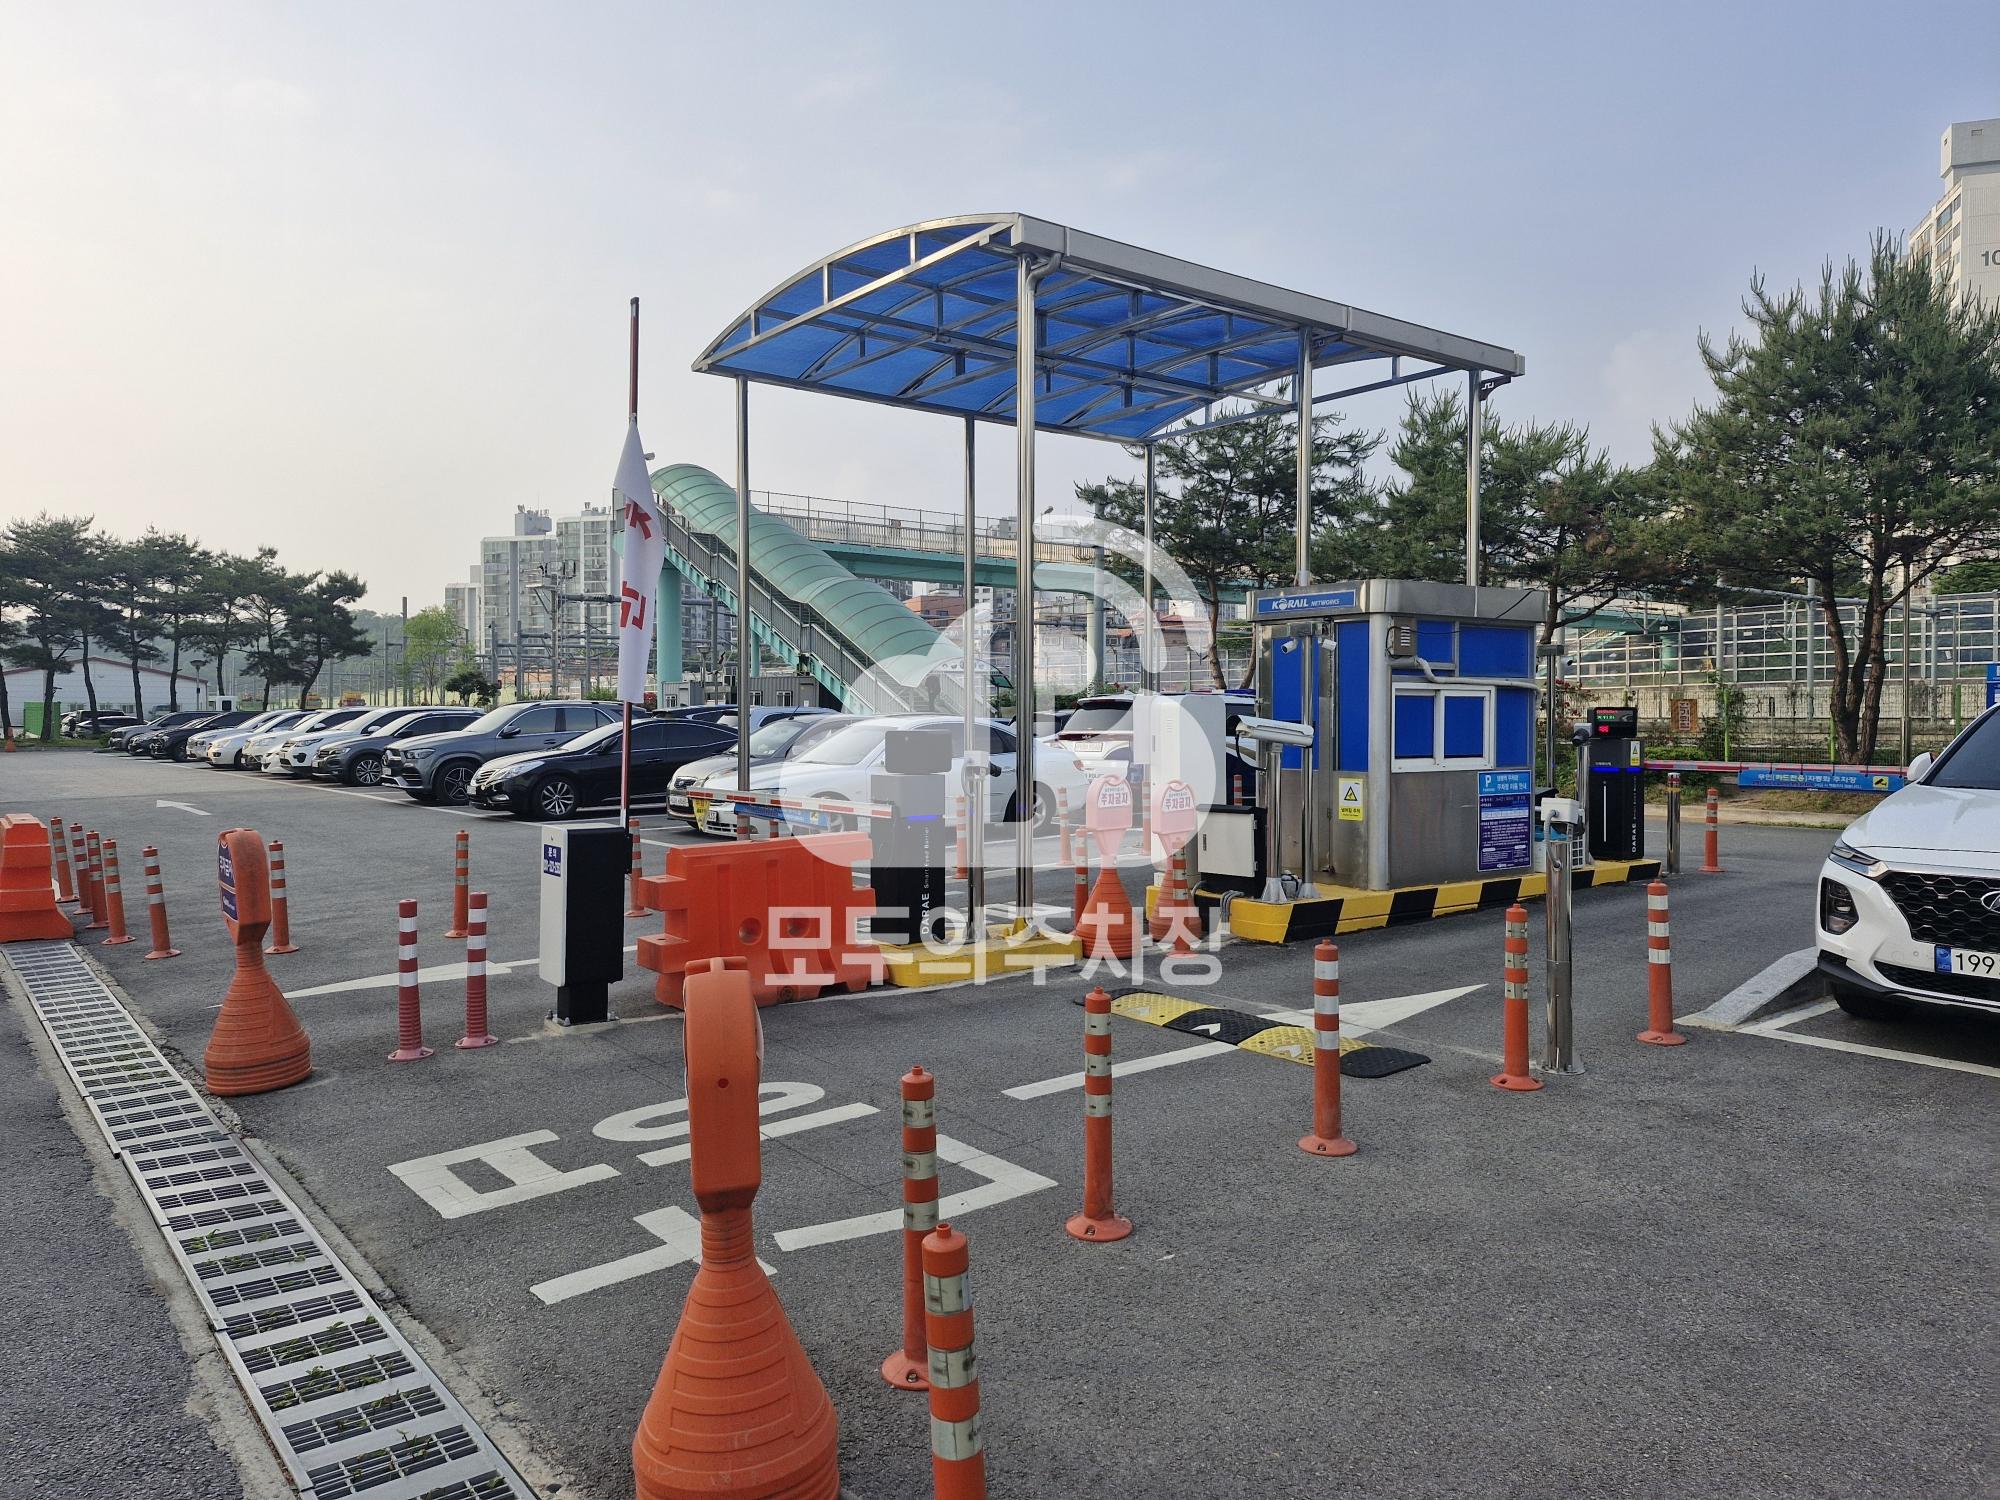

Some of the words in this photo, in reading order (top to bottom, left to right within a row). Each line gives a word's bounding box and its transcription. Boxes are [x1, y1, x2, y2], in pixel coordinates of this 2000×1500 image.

[1271, 598, 1308, 610] KORAIL
[1101, 792, 1128, 806] 주차금지
[1165, 796, 1191, 810] 주차금지
[921, 893, 930, 935] DARAE
[1955, 953, 2000, 976] 199
